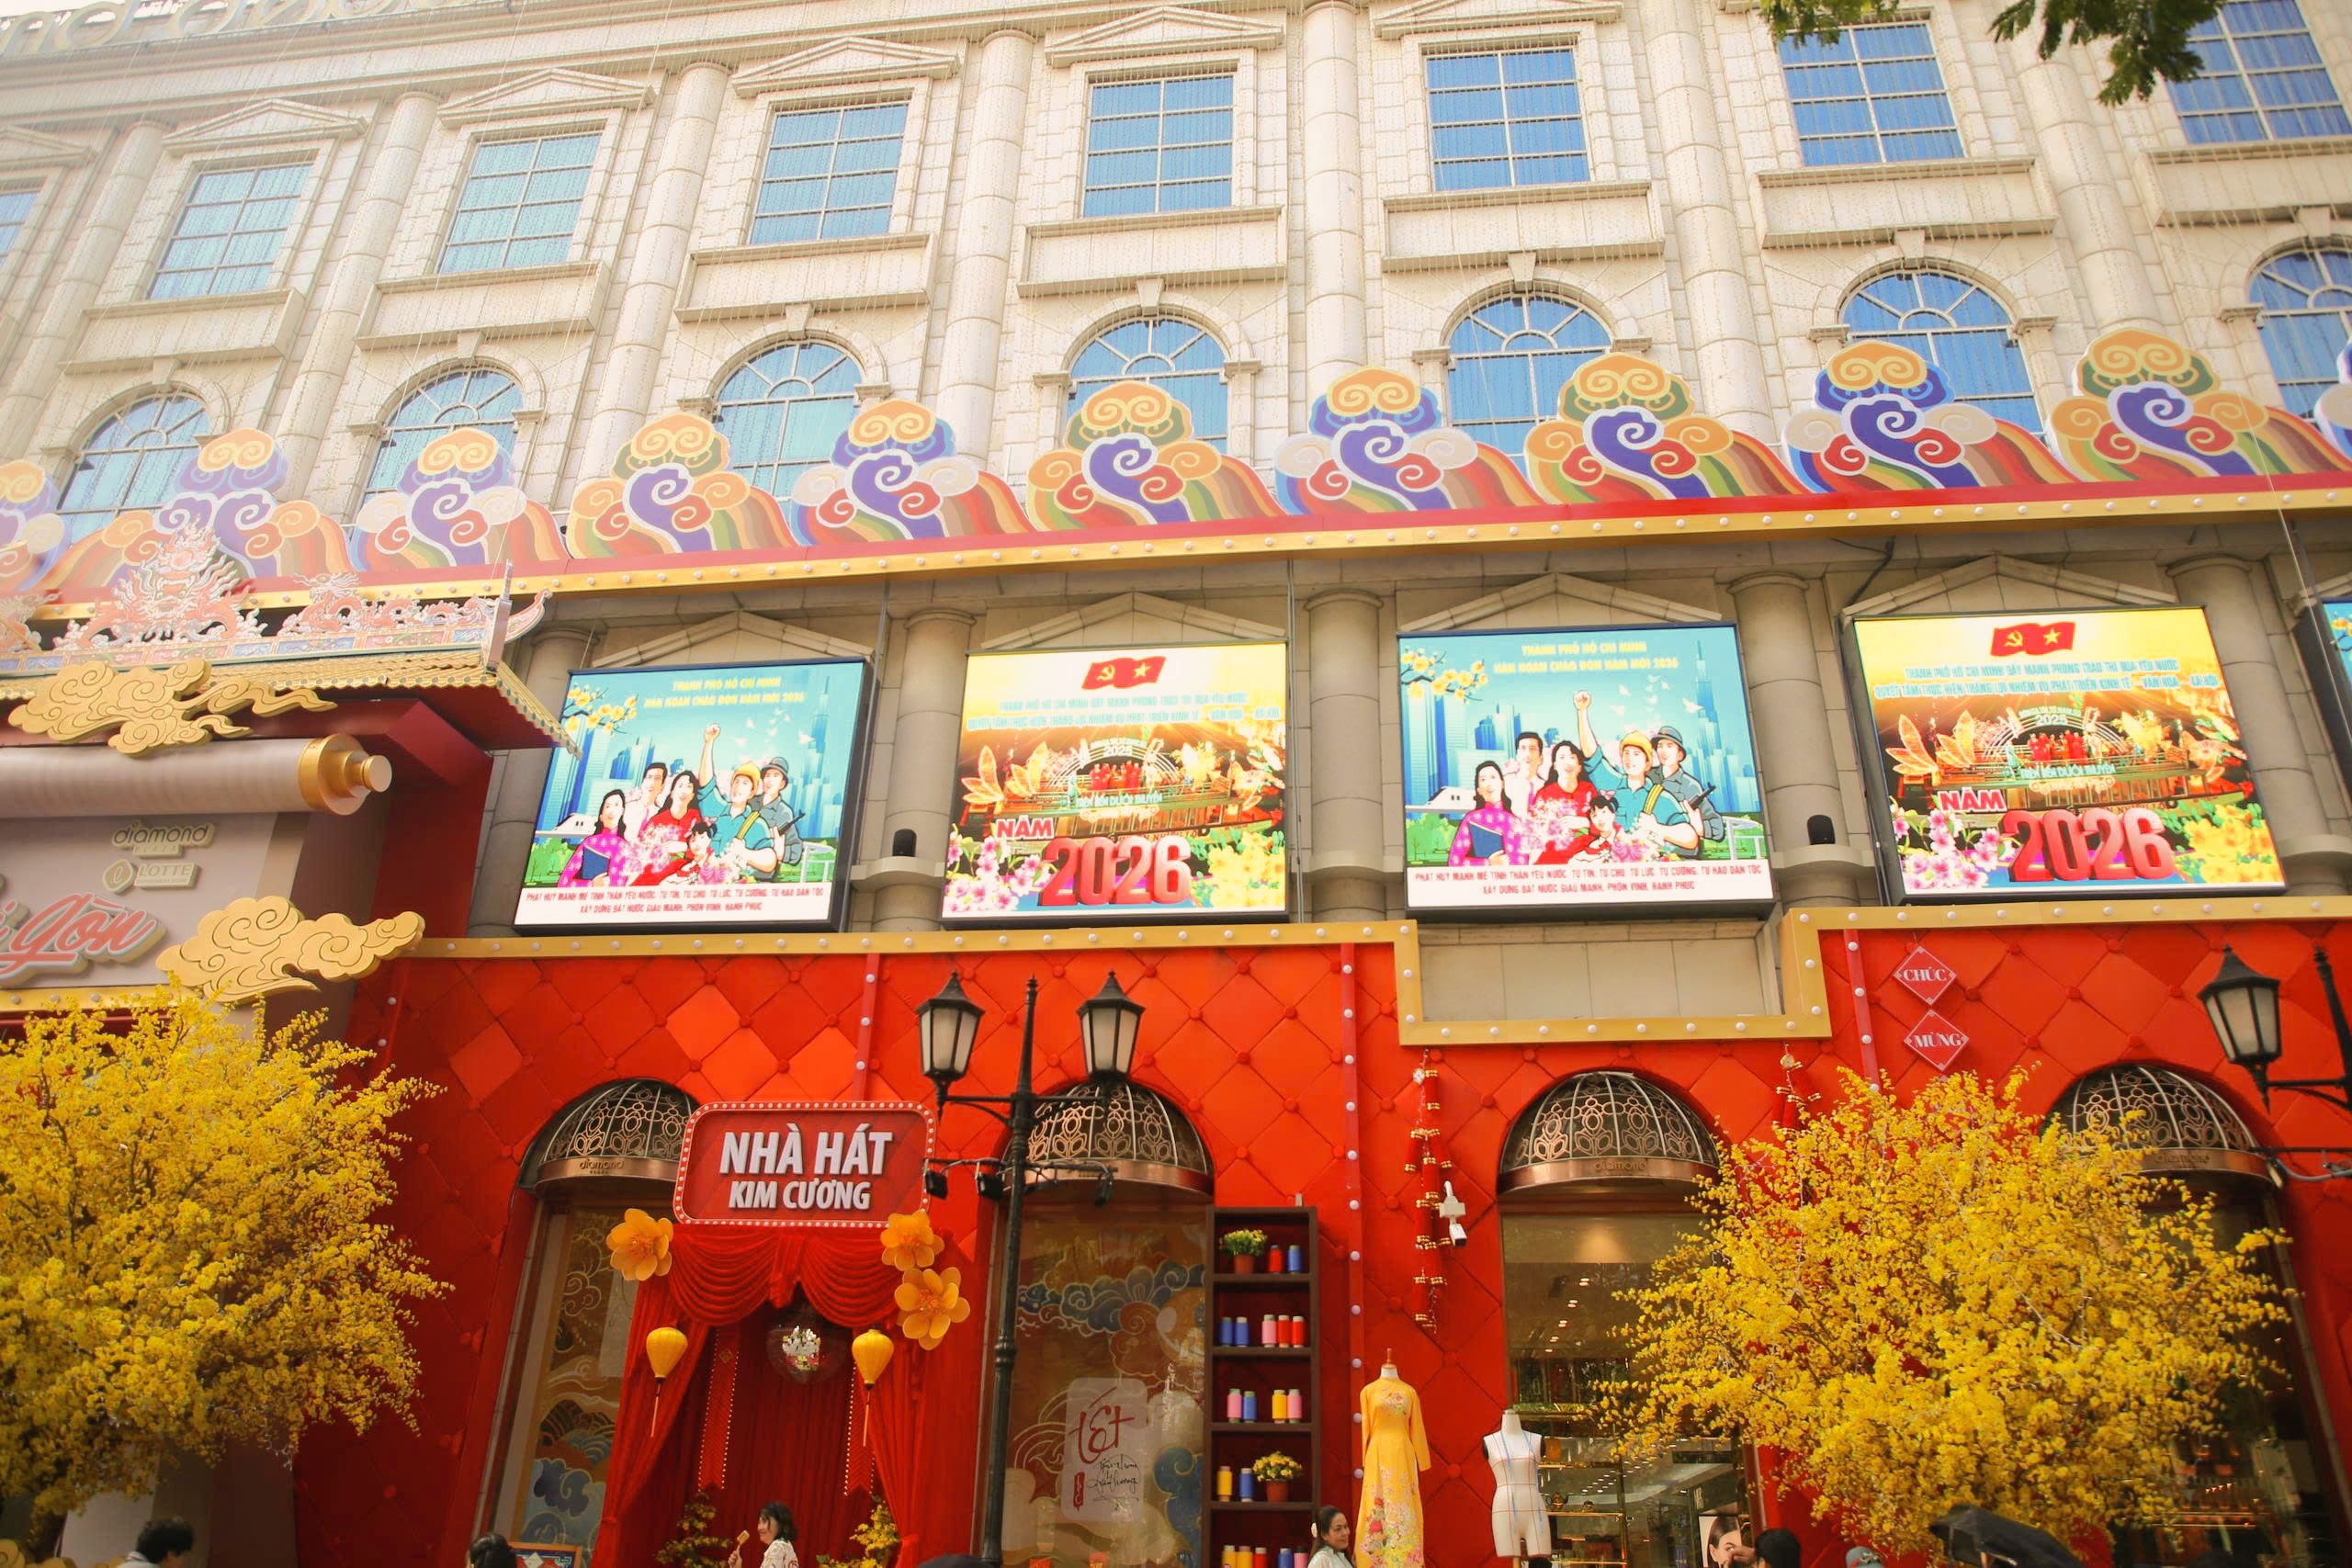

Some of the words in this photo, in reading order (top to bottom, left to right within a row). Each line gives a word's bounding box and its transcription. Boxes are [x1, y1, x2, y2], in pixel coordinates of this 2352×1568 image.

[1939, 787, 2007, 811] NĂM
[114, 821, 209, 843] diamond
[996, 815, 1055, 840] NĂM
[1998, 807, 2176, 882] 2026
[139, 864, 191, 876] LOTTE
[1038, 836, 1192, 906] 2026
[1903, 966, 1947, 982] CHÚC
[719, 1122, 804, 1175] NHÀ
[814, 1122, 893, 1175] HÁT
[580, 1157, 625, 1169] diamond
[729, 1180, 778, 1209] KIM
[782, 1178, 871, 1210] CƯƠNG
